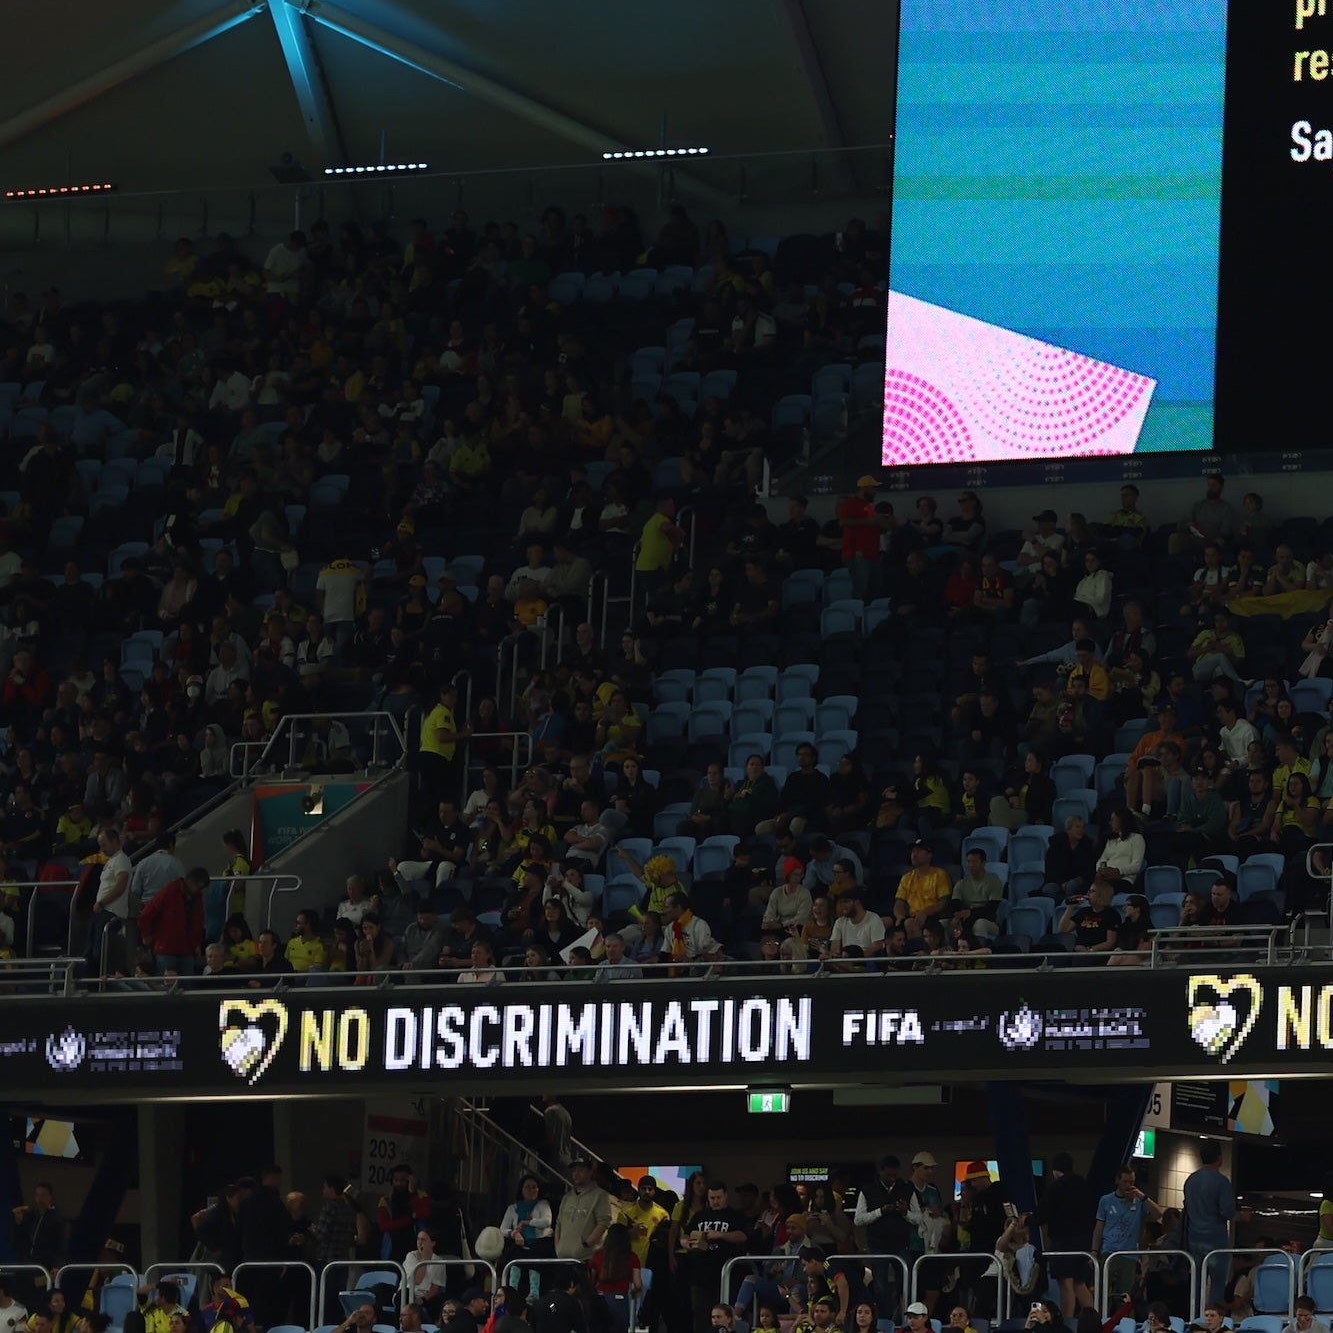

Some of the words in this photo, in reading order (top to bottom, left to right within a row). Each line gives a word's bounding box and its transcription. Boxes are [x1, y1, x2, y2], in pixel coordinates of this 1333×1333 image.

[300, 1008, 370, 1071] NO
[384, 997, 812, 1071] DISCRIMINATION
[842, 1011, 924, 1045] FIFA
[369, 1138, 396, 1160] 203
